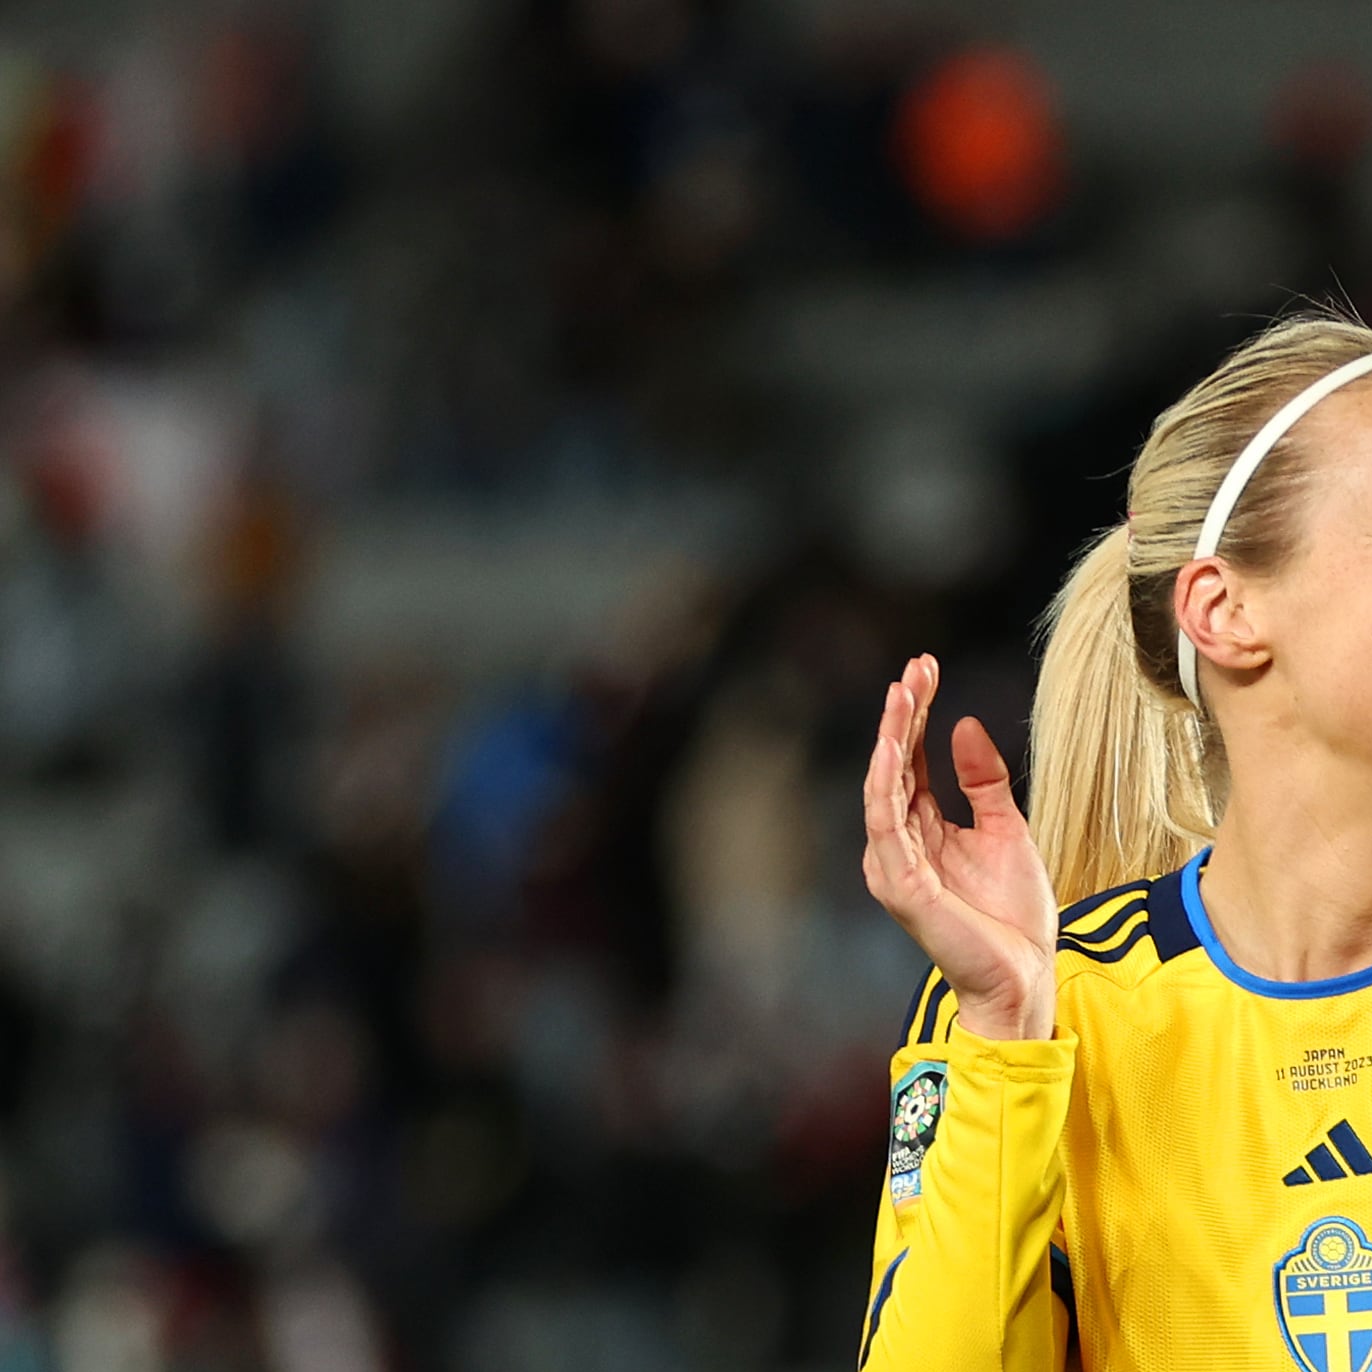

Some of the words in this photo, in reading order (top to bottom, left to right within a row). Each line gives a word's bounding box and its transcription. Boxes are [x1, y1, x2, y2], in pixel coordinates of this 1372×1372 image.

[1303, 1047, 1345, 1062] JAPAN
[1275, 1067, 1286, 1081] 11
[1290, 1062, 1339, 1078] AUGUST
[1292, 1072, 1358, 1092] AUCKLAND
[1296, 1271, 1372, 1290] SVERIGE
